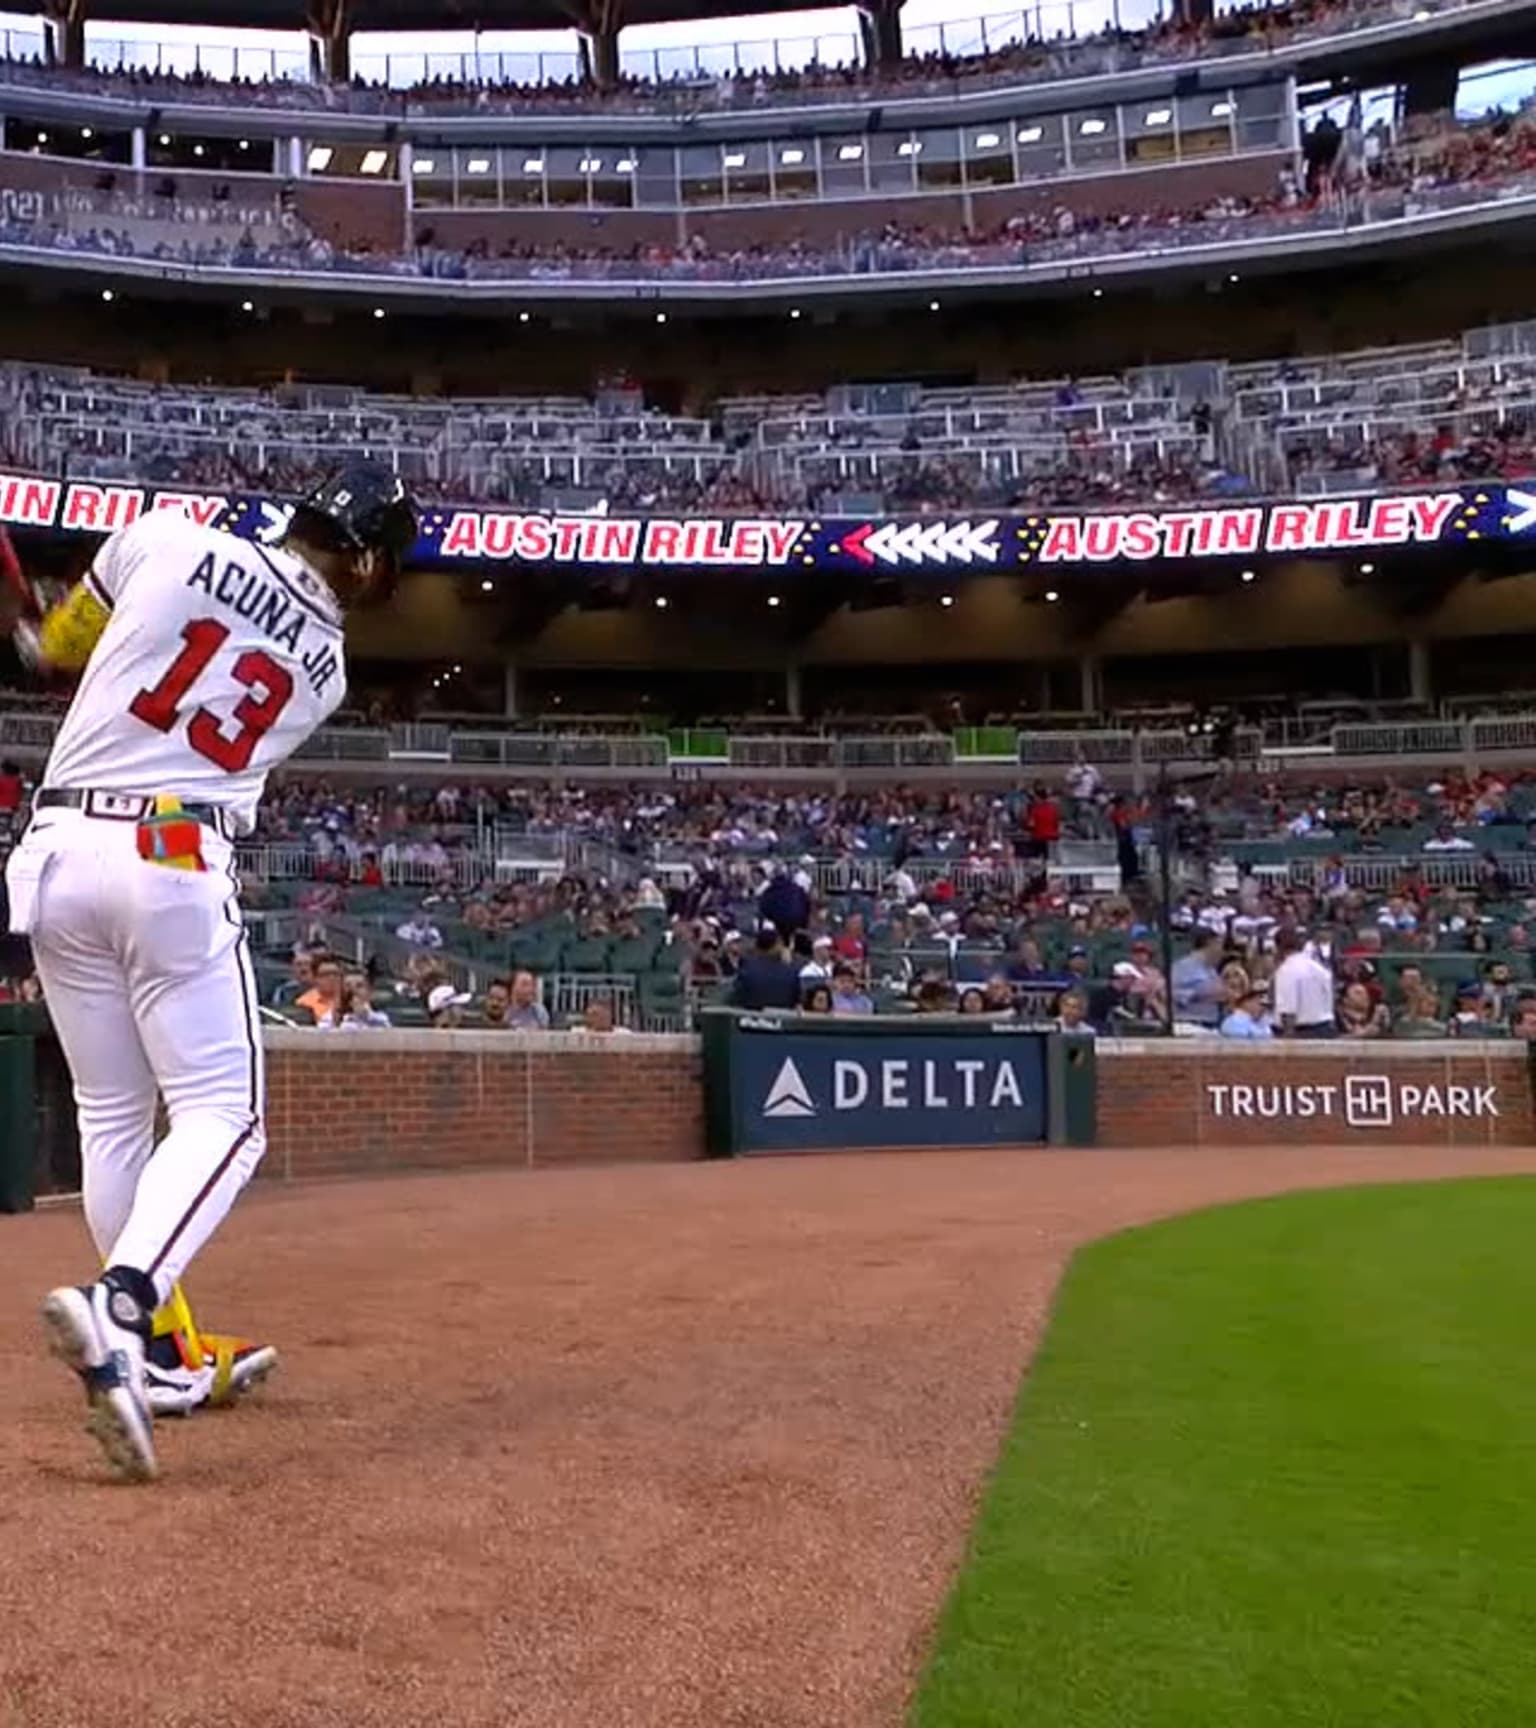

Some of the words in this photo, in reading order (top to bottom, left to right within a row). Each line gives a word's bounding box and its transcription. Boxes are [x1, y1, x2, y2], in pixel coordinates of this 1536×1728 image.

[441, 512, 642, 562] AUSTIN
[642, 518, 805, 565] RILEY
[1039, 507, 1264, 563] AUSTIN
[1265, 494, 1463, 551] RILEY
[128, 617, 294, 774] 13
[834, 1059, 1023, 1110] DELTA
[1208, 1085, 1337, 1116] TRUIST
[1401, 1085, 1500, 1117] PARK
